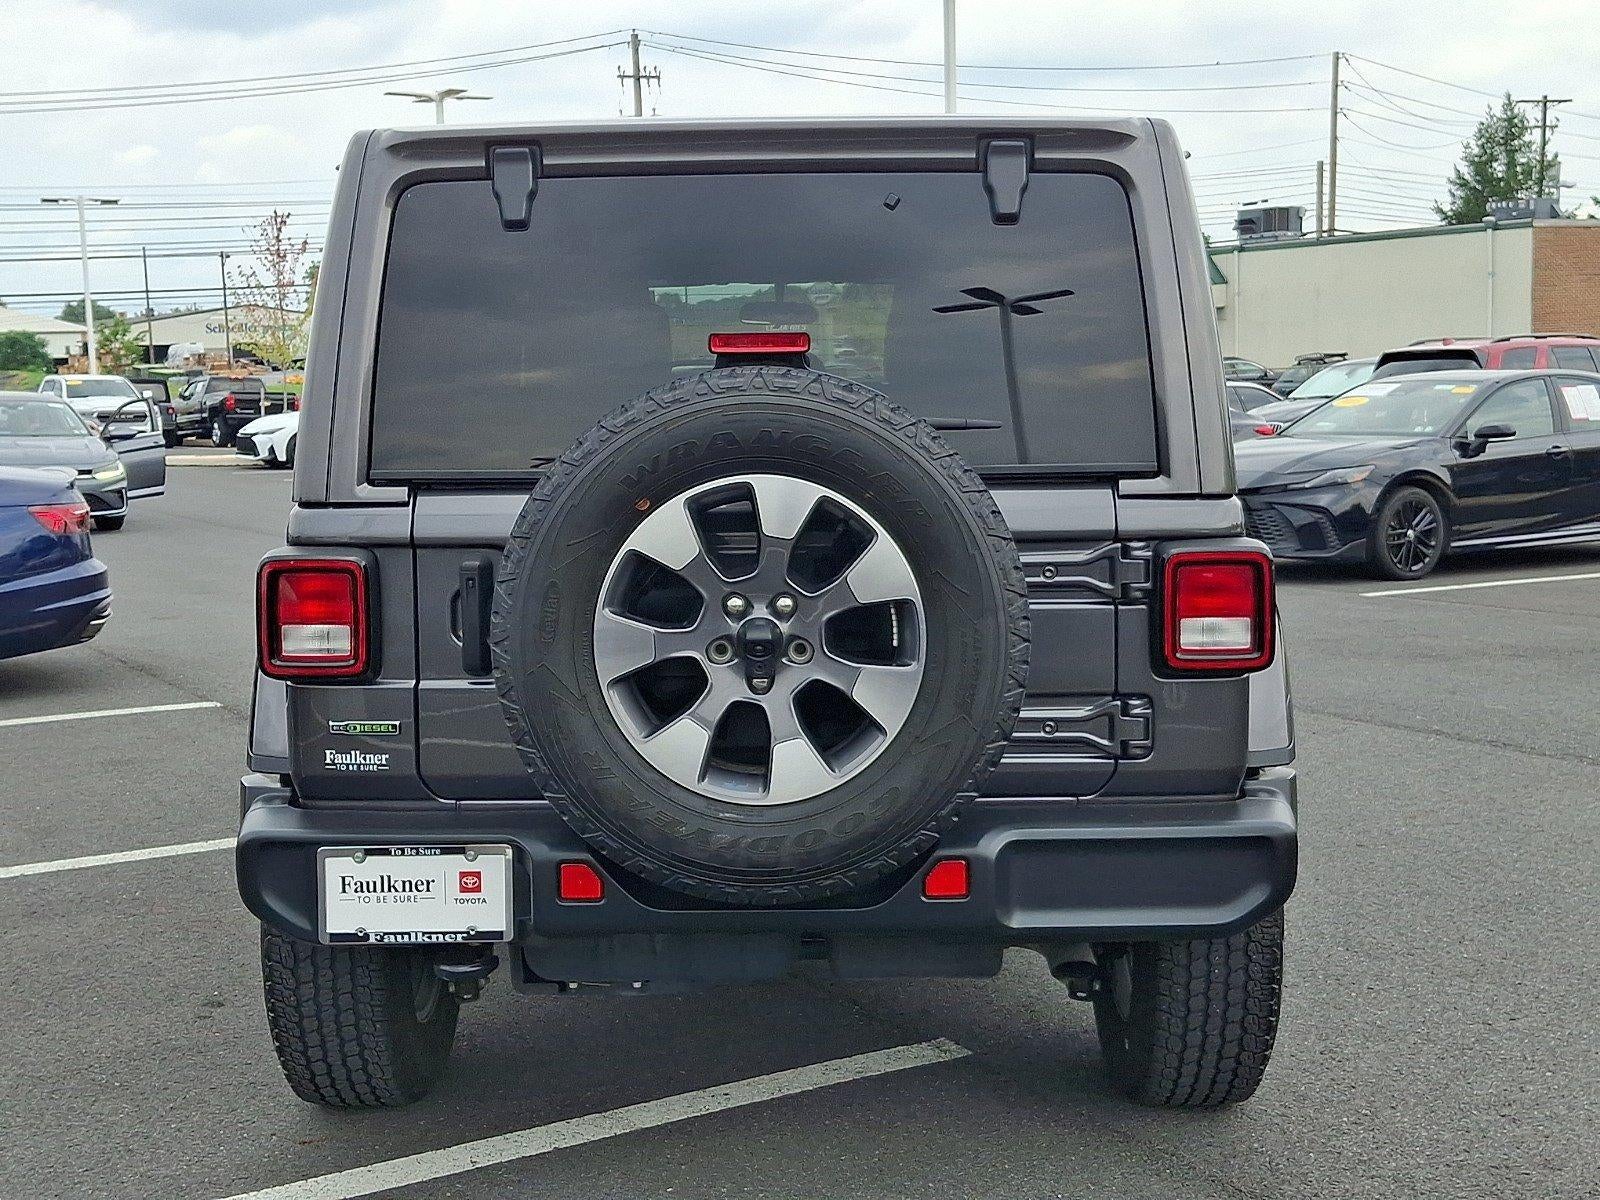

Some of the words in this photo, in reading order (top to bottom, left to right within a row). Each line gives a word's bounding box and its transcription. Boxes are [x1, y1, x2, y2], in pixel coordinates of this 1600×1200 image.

[325, 750, 389, 764] Faulkner
[389, 848, 401, 856] To
[404, 847, 416, 856] Be
[418, 847, 440, 855] Sure
[339, 875, 435, 894] Faulkner
[393, 895, 418, 903] SURE
[367, 932, 467, 942] Faulkner
